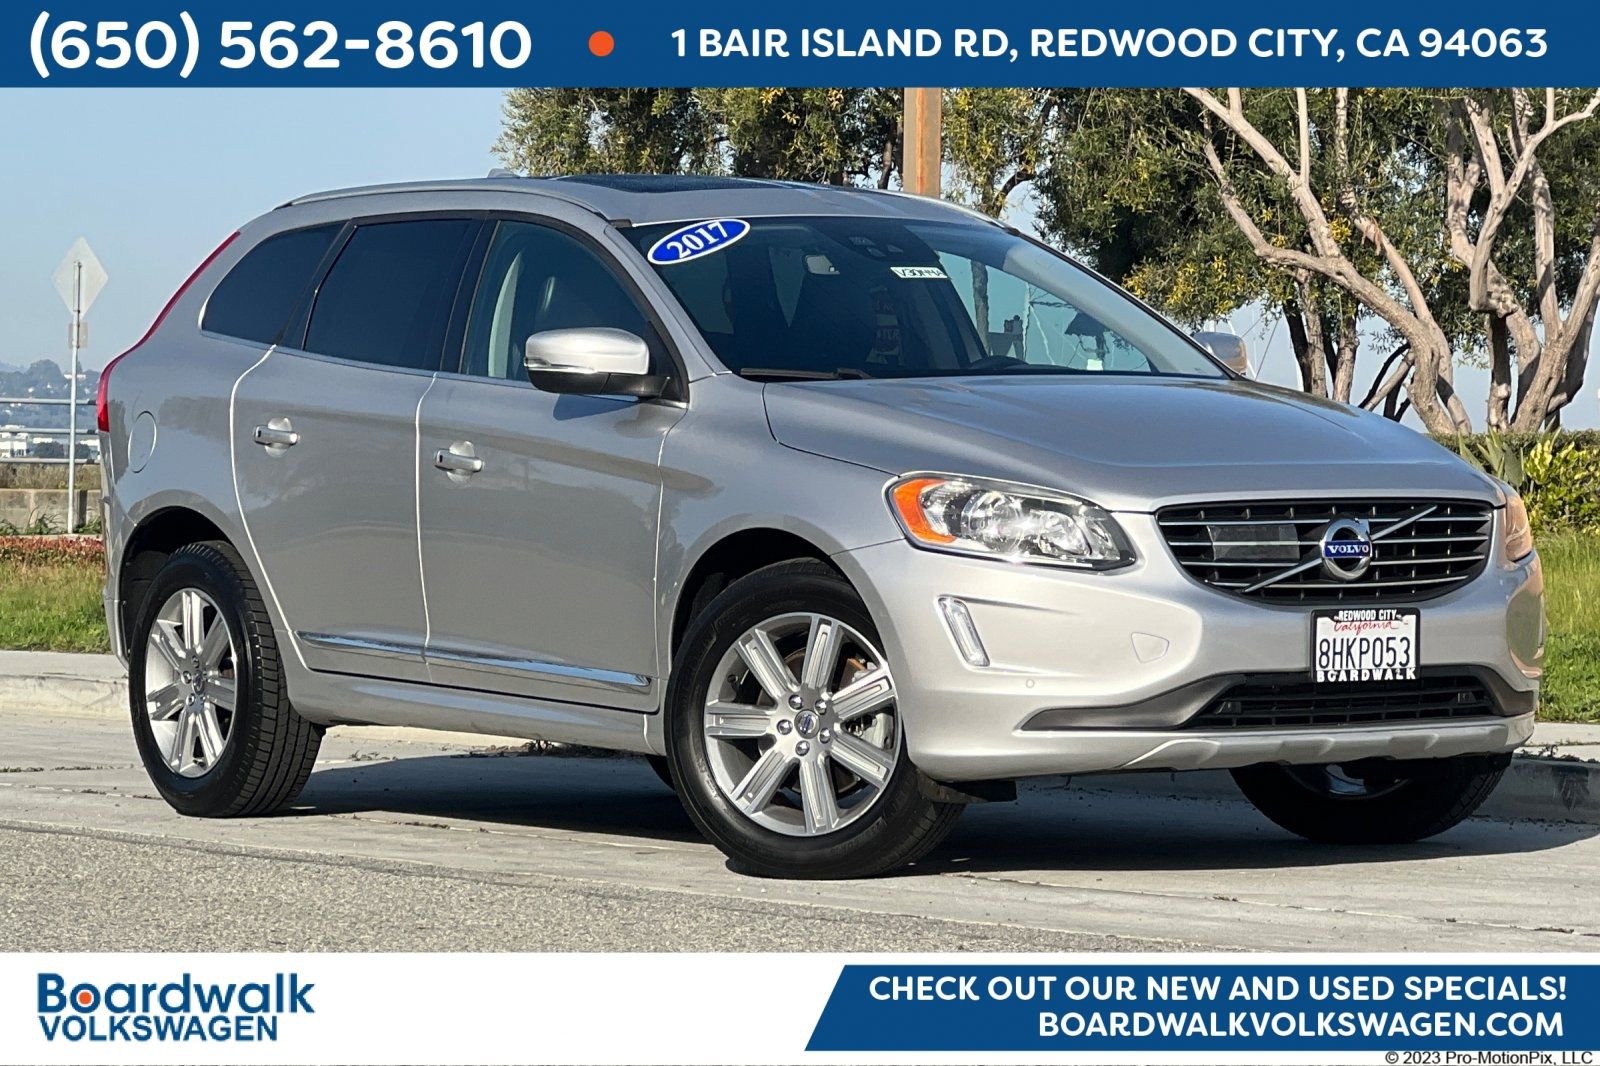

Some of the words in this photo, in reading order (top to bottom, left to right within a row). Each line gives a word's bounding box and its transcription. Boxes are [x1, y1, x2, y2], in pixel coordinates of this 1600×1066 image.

[666, 221, 728, 258] 2017
[1328, 544, 1369, 554] VOLVO
[1339, 609, 1376, 621] REDWOOD
[1378, 609, 1398, 621] CITY
[1334, 620, 1401, 636] California
[1318, 636, 1411, 669] 8HKP053
[1316, 667, 1417, 682] BOARDWALK
